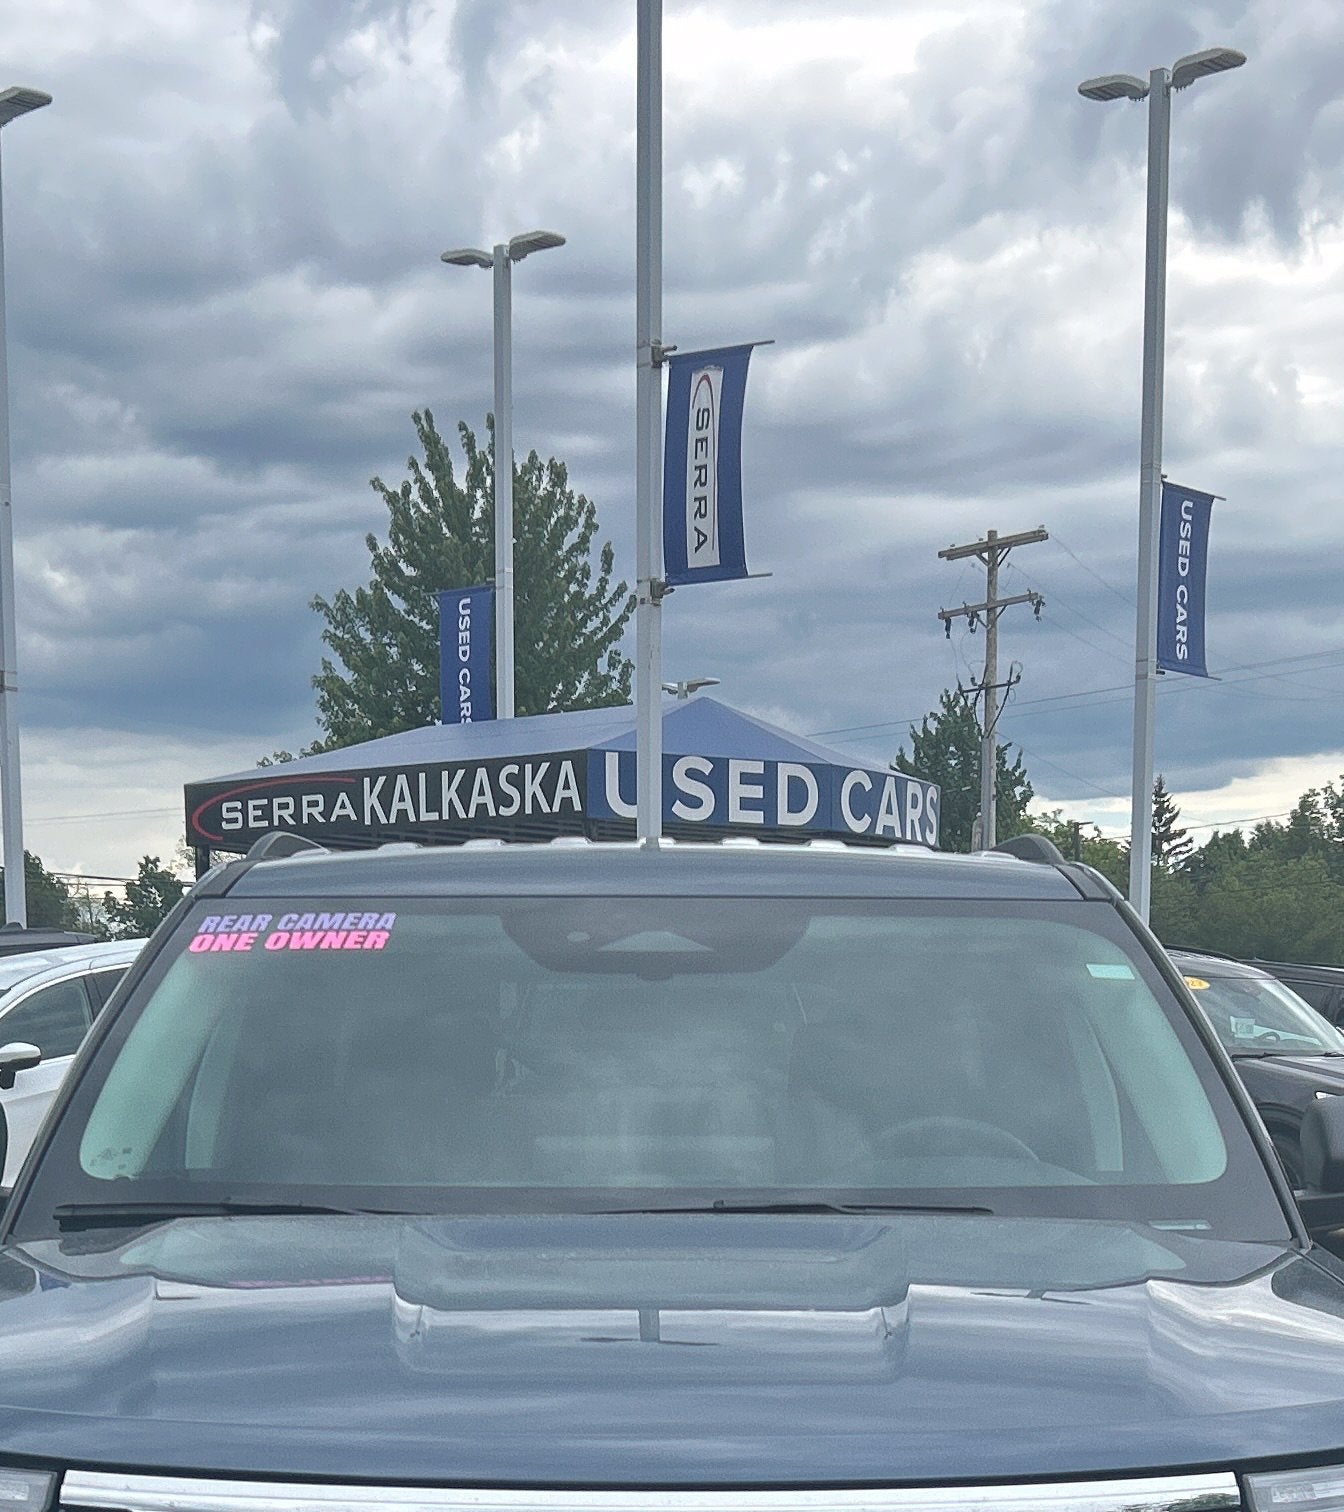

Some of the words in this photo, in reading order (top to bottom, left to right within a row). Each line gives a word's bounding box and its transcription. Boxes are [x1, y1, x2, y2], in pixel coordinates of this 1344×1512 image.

[693, 407, 710, 553] SERRA
[1178, 500, 1193, 576] USED
[458, 597, 471, 662] USED
[1176, 585, 1188, 660] CARS
[221, 792, 358, 830] SERRA
[363, 760, 583, 826] KALKASKA
[605, 751, 819, 827] USED
[840, 769, 939, 846] CARS
[188, 931, 259, 953] ONE
[263, 929, 391, 951] OWNER
[197, 913, 273, 933] REAR
[276, 911, 398, 932] CAMERA
